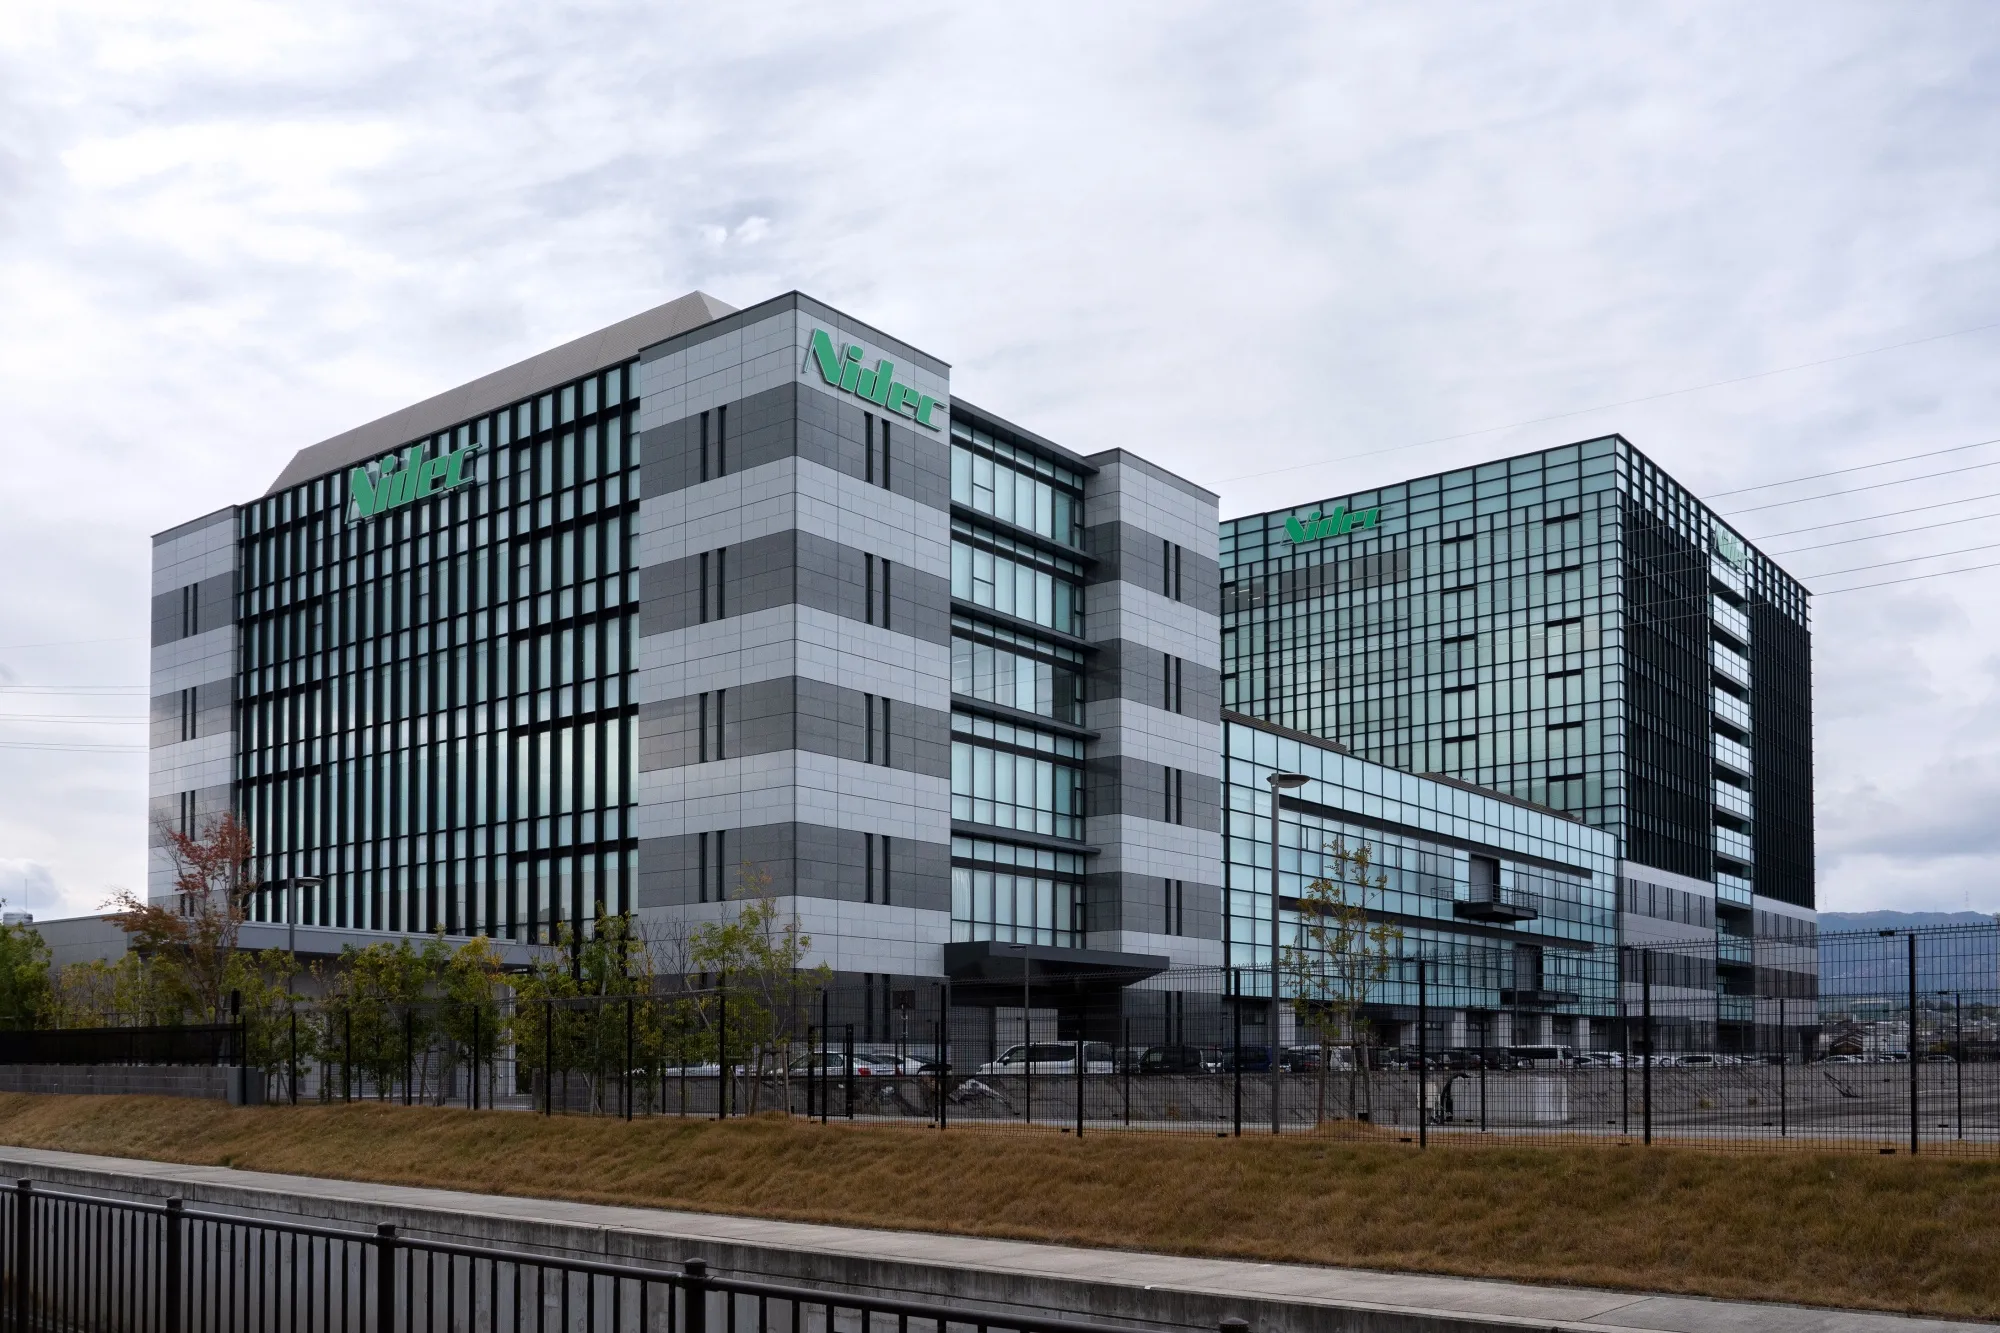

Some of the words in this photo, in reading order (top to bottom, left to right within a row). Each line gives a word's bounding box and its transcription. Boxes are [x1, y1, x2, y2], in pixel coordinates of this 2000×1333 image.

[802, 328, 948, 432] Nidec
[345, 443, 482, 524] Nidec
[1281, 505, 1391, 546] Nidec
